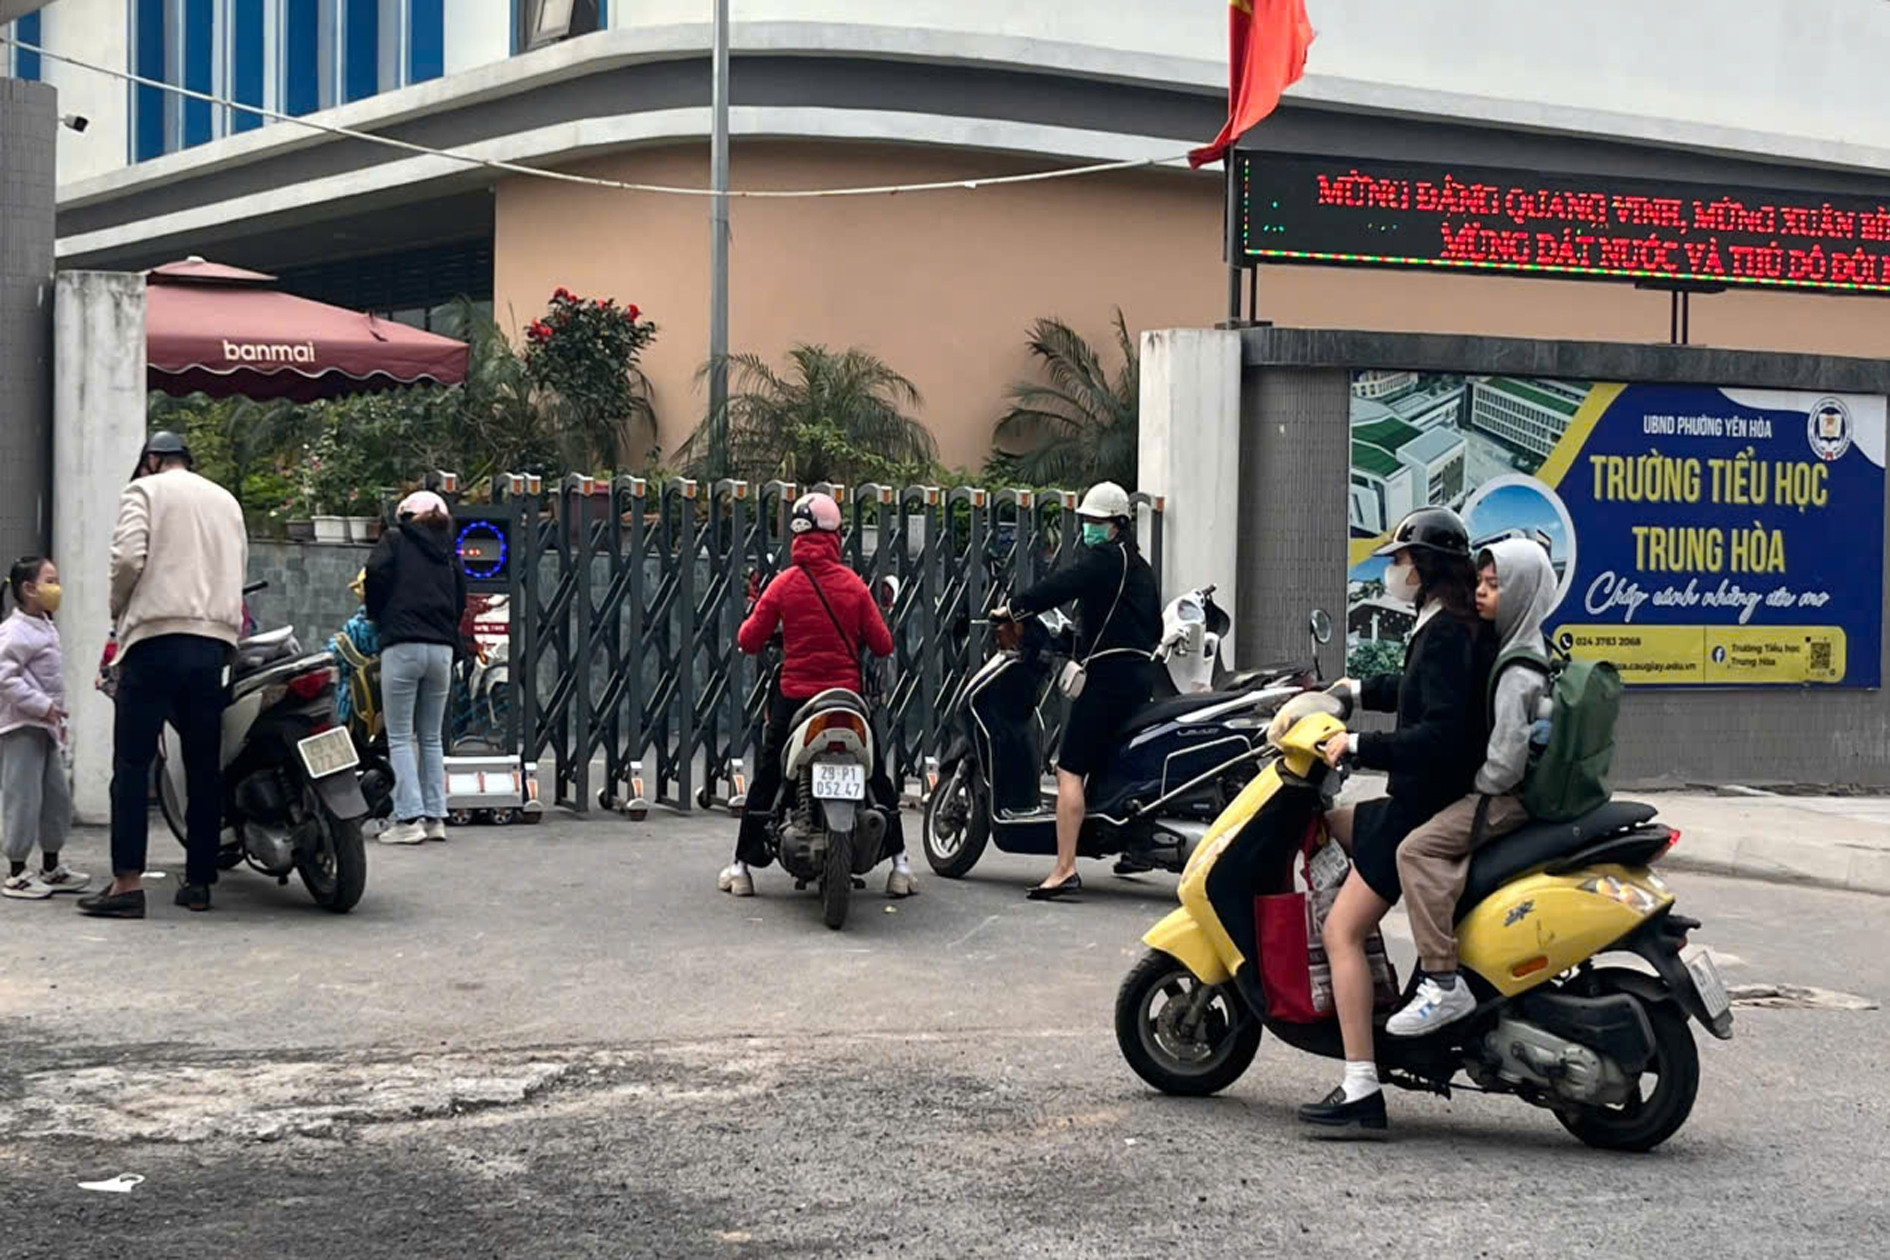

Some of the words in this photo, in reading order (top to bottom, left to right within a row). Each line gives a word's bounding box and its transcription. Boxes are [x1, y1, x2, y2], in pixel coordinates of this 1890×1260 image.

[1683, 236, 1725, 274] VÀ
[222, 339, 316, 362] banmai
[1643, 414, 1675, 435] UBND
[1677, 414, 1722, 438] PHƯỜNG
[1725, 415, 1747, 438] YÊN
[1749, 416, 1772, 439] HÒA
[1590, 448, 1701, 503] TRƯỜNG
[1708, 446, 1769, 505] TIỂU
[1774, 461, 1829, 513] HỌC
[1632, 526, 1723, 573] TRUNG
[1731, 520, 1786, 573] HÒA
[1652, 578, 1699, 608] cánh
[1702, 578, 1762, 625] những
[1799, 588, 1830, 608] mơ
[1575, 636, 1593, 647] 024
[1731, 642, 1763, 655] Trường
[1730, 656, 1757, 668] Trung
